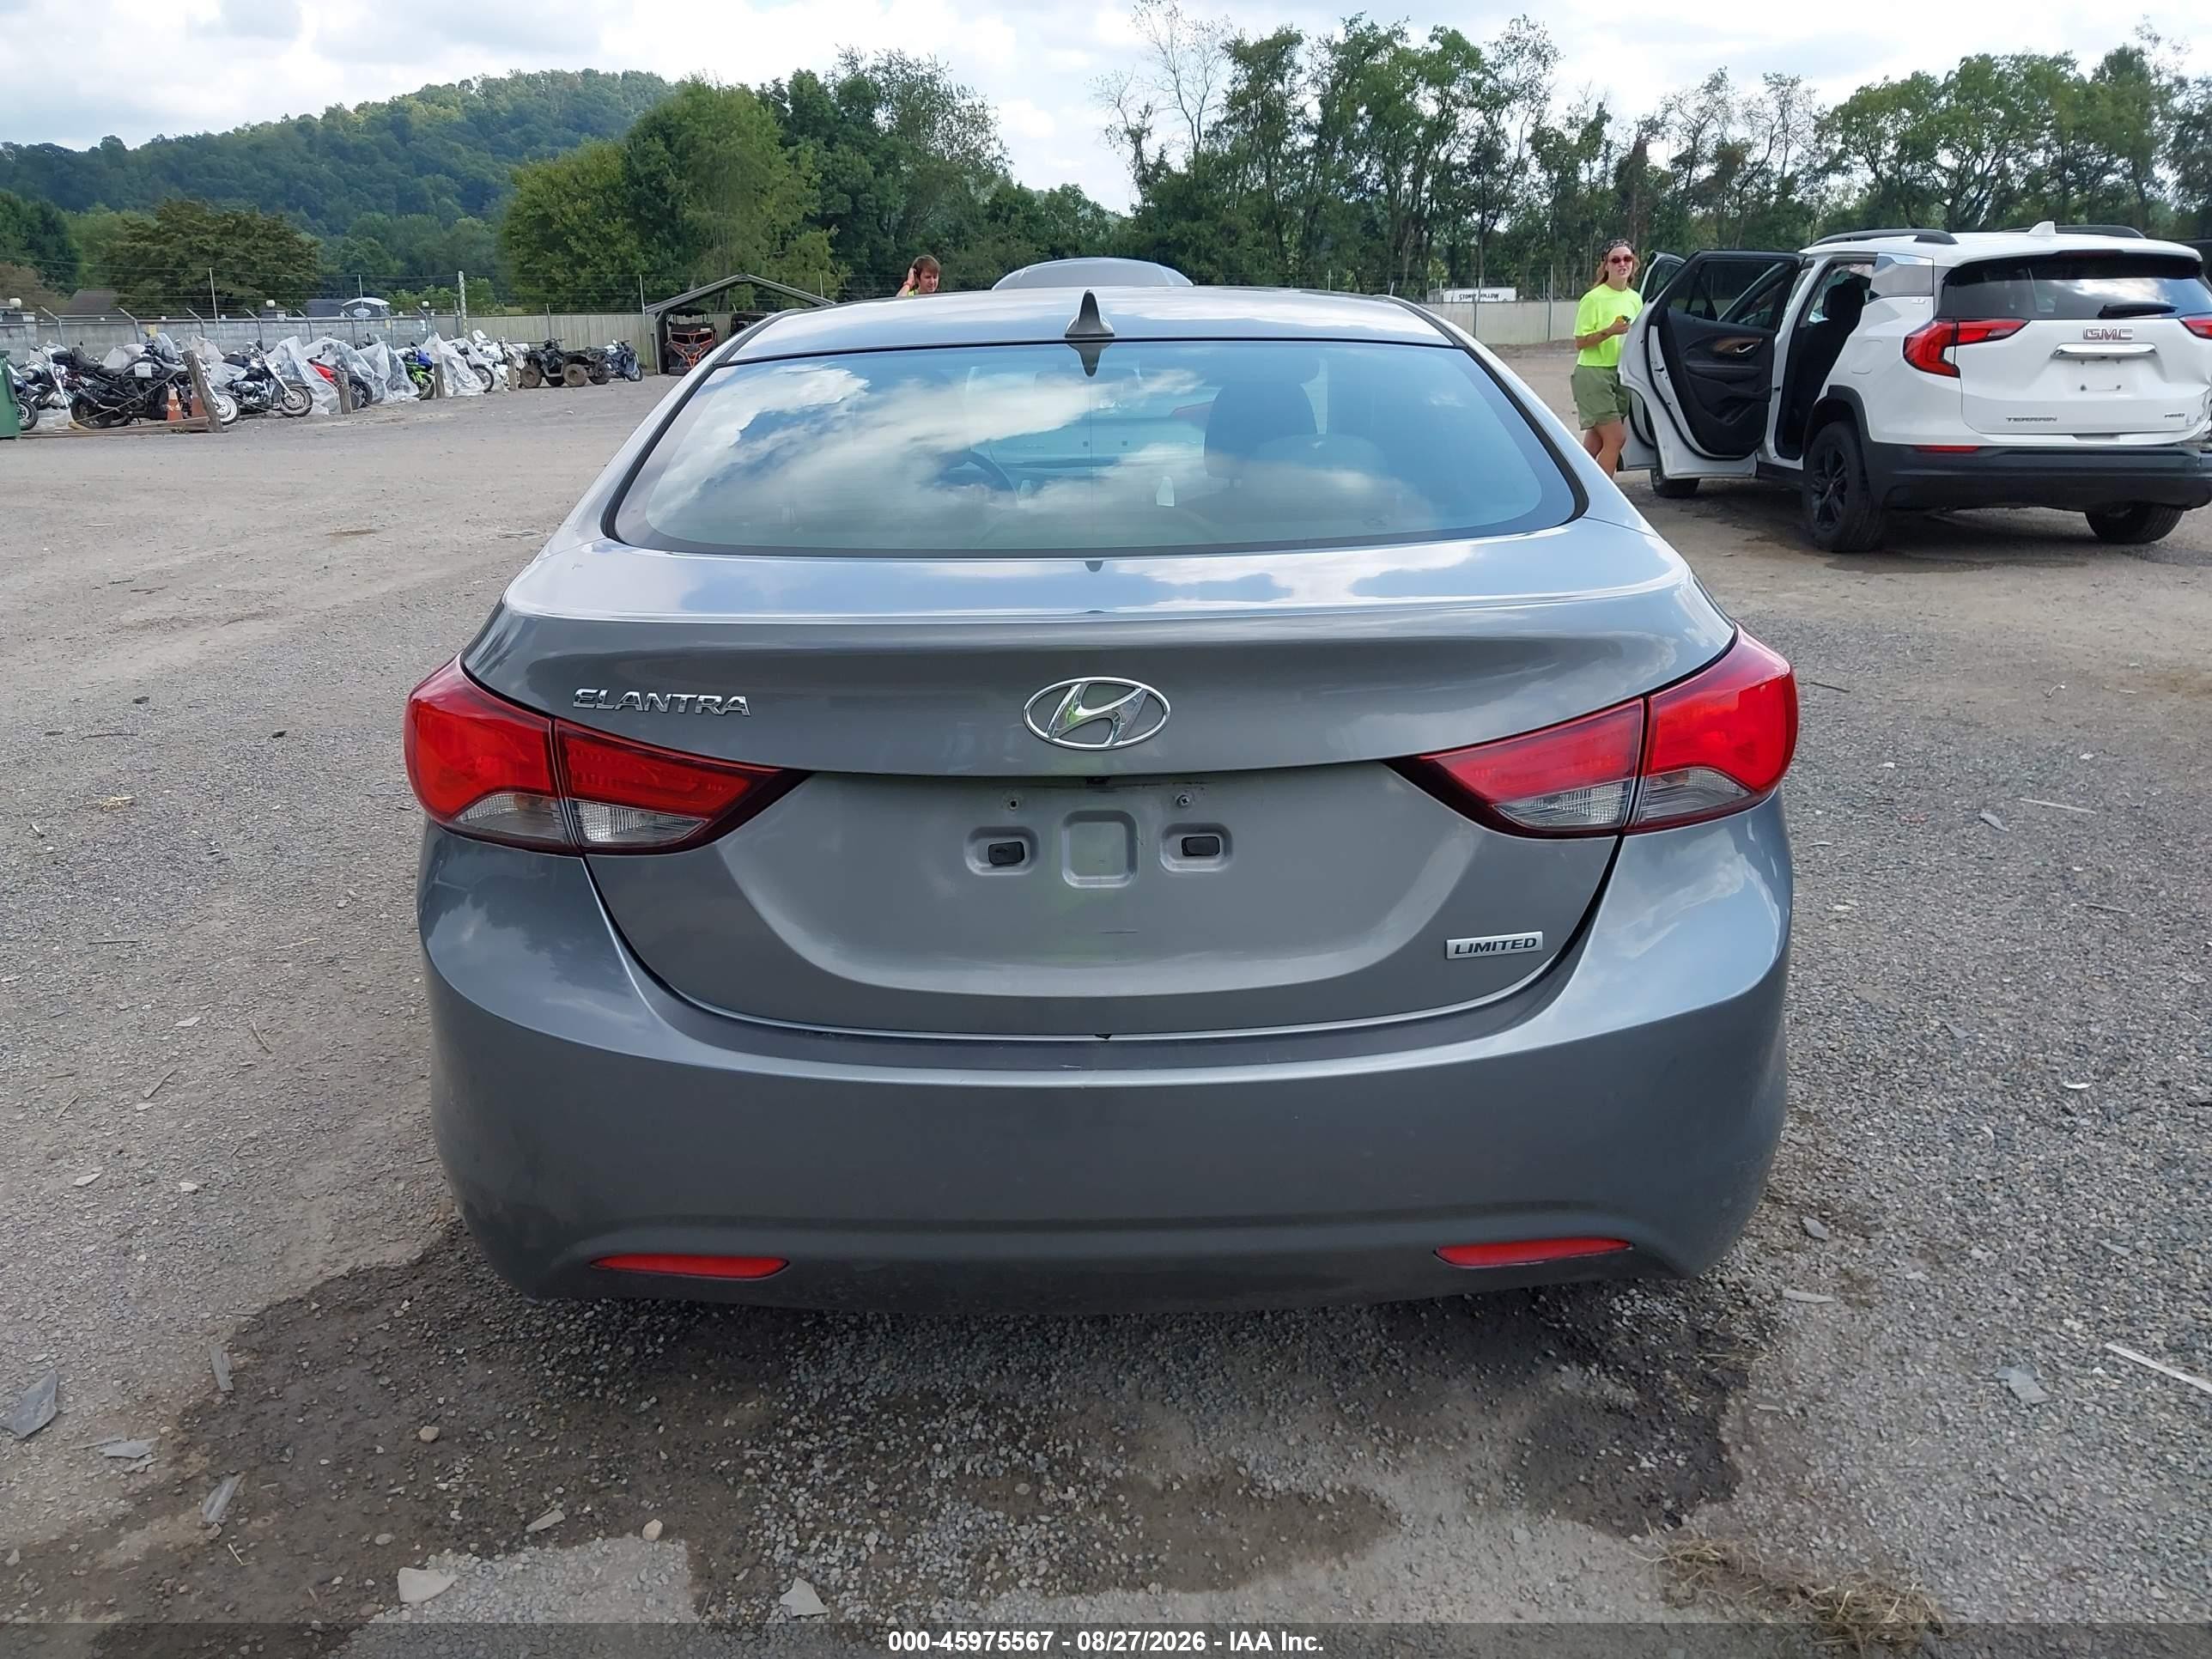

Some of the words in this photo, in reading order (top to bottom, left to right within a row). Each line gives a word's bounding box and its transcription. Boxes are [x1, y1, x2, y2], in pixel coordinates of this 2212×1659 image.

[2083, 327, 2133, 340] GMC
[571, 685, 750, 716] ELANTRA
[1455, 938, 1536, 955] LIMITED
